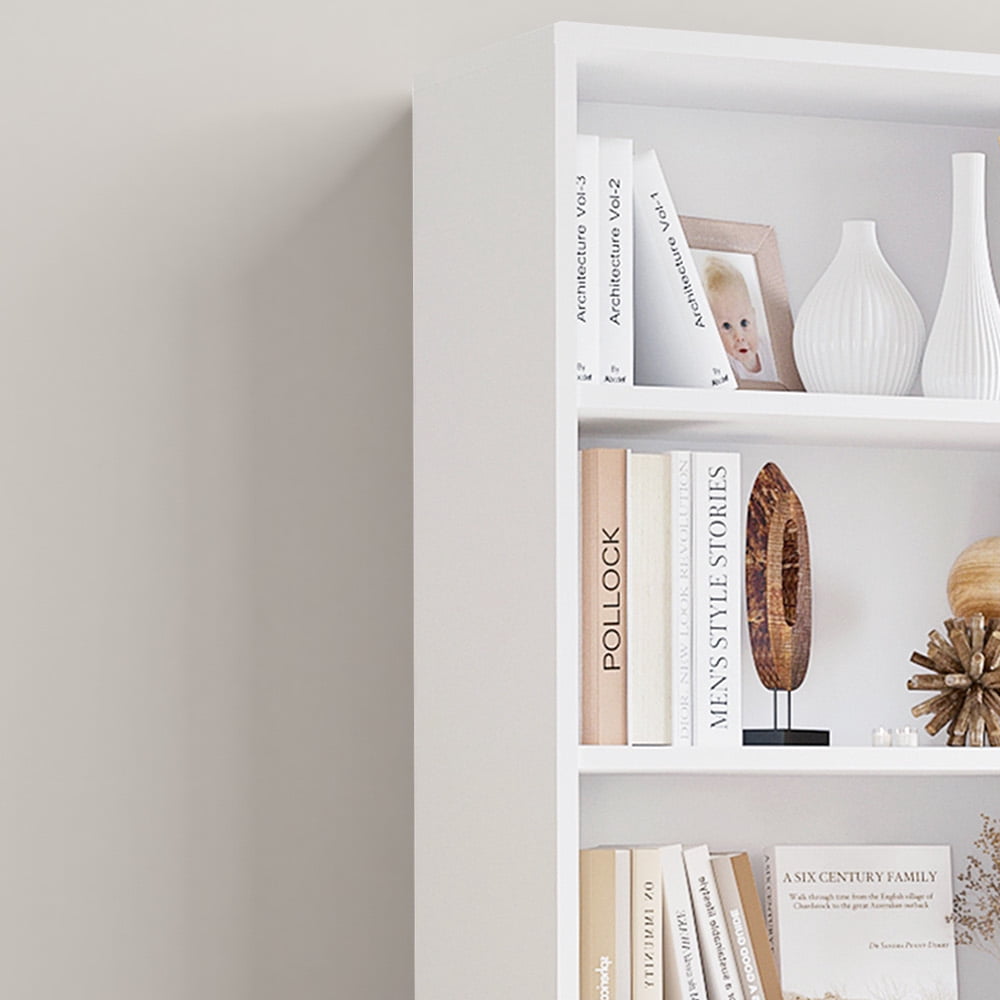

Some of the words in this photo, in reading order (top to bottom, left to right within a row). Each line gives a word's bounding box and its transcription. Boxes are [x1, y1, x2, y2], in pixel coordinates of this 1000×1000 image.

[576, 175, 587, 218] Vol-3
[609, 178, 621, 222] Vol-2
[650, 191, 671, 233] Vol-1
[576, 224, 587, 323] Architecture
[609, 227, 621, 326] Architecture
[668, 236, 706, 329] Architecture
[708, 465, 727, 568] STORIES
[602, 527, 621, 671] POLLOCK
[709, 575, 728, 649] STYLE
[710, 657, 728, 729] MEN'S
[782, 872, 791, 882] A
[794, 872, 816, 883] SIX
[819, 872, 884, 883] CENTURY
[887, 871, 938, 882] FAMILY
